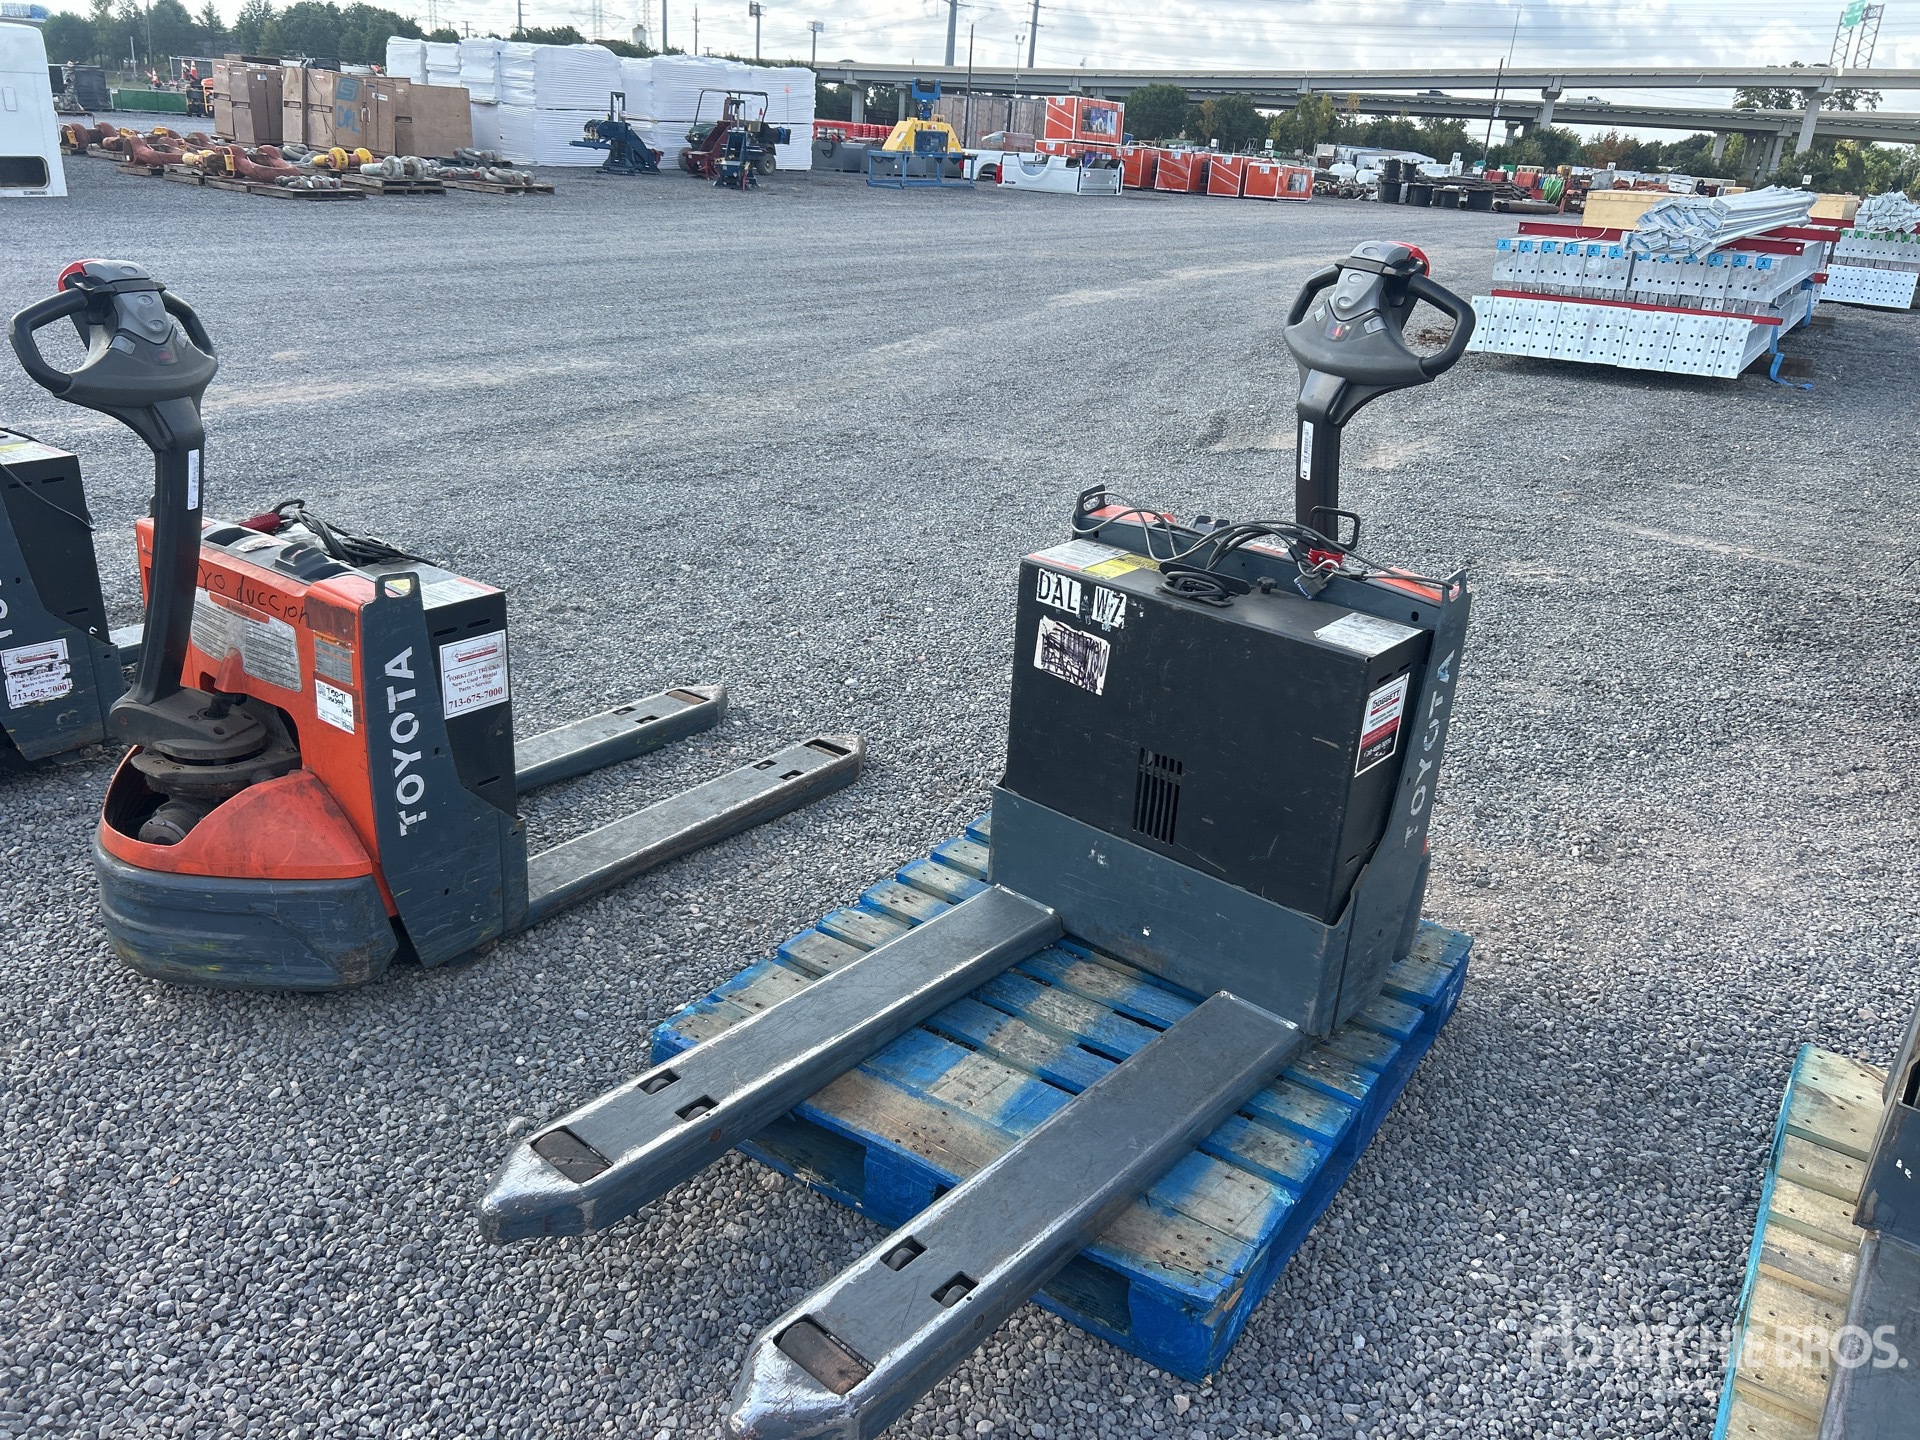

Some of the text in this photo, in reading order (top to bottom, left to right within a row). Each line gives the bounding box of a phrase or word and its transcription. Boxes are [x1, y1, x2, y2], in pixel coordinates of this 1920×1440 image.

[1038, 570, 1077, 612] DAL
[448, 664, 500, 682] FORKLIFT TRUCKS
[467, 676, 479, 684] Used
[482, 671, 498, 679] Rental
[12, 684, 67, 701] 713-675-7000
[448, 687, 503, 709] 713-675-7000
[384, 646, 427, 837] TOYOTA
[1404, 649, 1456, 848] TOYOTA
